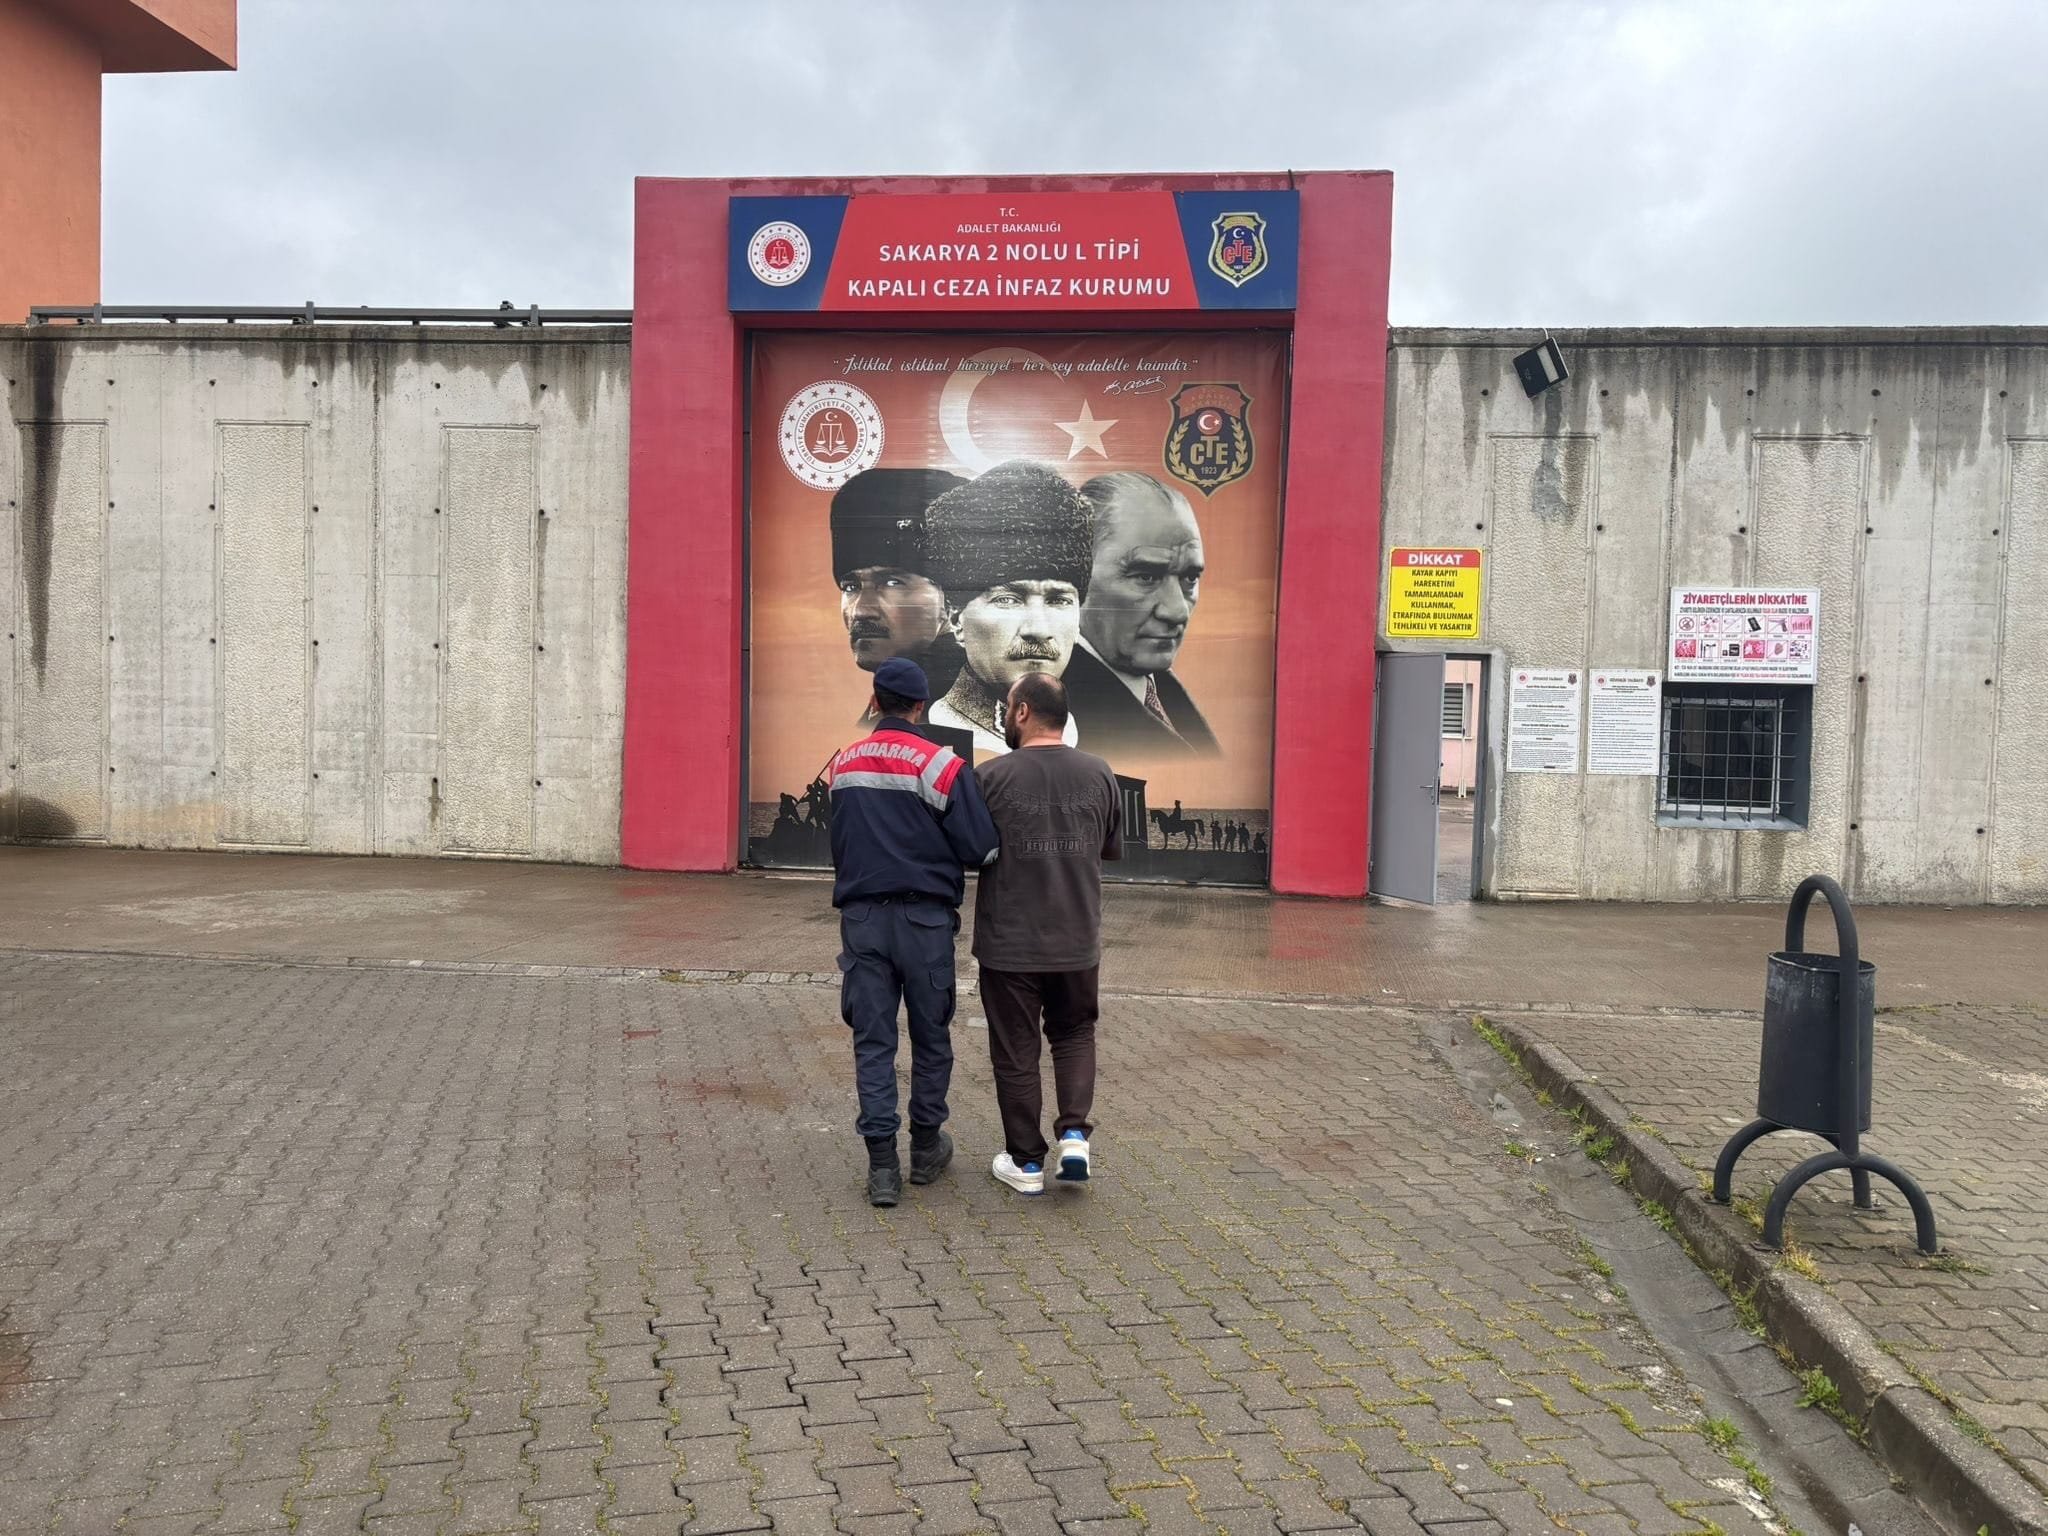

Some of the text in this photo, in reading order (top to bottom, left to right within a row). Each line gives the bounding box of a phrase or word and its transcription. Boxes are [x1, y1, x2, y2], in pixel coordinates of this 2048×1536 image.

[1000, 208, 1019, 217] T.C.
[957, 221, 1061, 233] ADALET BAKANLIĞI
[879, 238, 1139, 262] SAKARYA 2 NOLU L TİPİ
[848, 274, 1170, 297] KAPALI CEZA İNFAZ KURUMU
[1022, 358, 1045, 371] her
[841, 402, 863, 425] ADALET
[1190, 435, 1228, 465] CTE
[1201, 467, 1217, 475] 1923
[1408, 551, 1463, 565] DİKKAT
[1412, 569, 1433, 577] KAYAR
[1404, 590, 1464, 599] TAMAMLAMADAN
[1683, 592, 1807, 606] ZİYARETÇİLERİN DİKKATİNE
[1411, 601, 1456, 610] KULLANMAK,
[1393, 611, 1473, 620] ETRAFINDA BULUNMAK
[1393, 621, 1427, 630] TEHLİKELİ
[1440, 623, 1472, 631] YASAKTIR
[840, 742, 927, 767] JANDARMA
